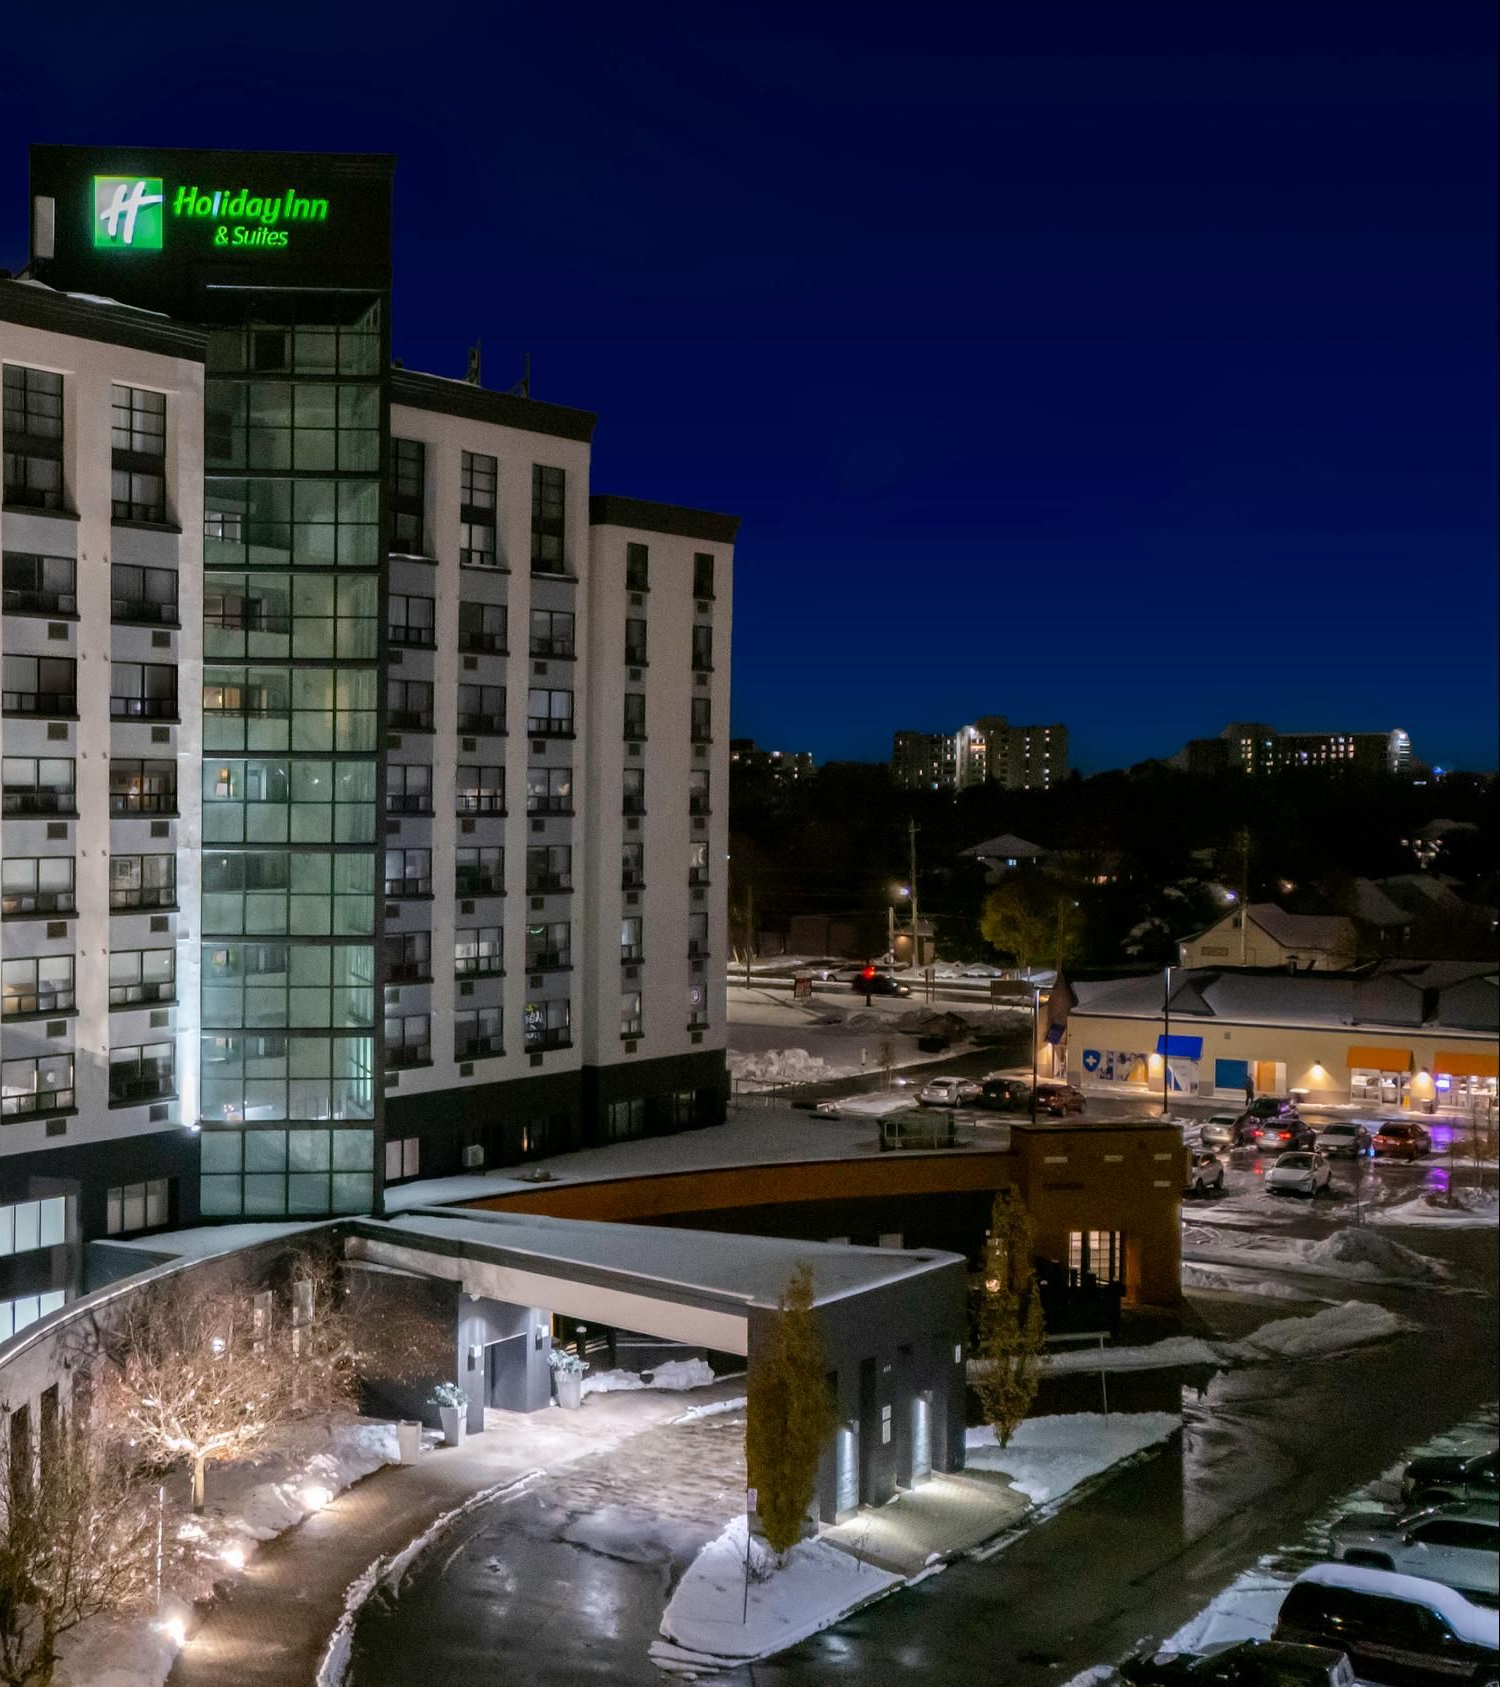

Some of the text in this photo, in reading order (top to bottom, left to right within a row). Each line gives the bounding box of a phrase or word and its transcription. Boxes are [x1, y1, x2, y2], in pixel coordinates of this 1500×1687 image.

[173, 186, 329, 224] Holiday Inn
[214, 226, 289, 246] & Suites
